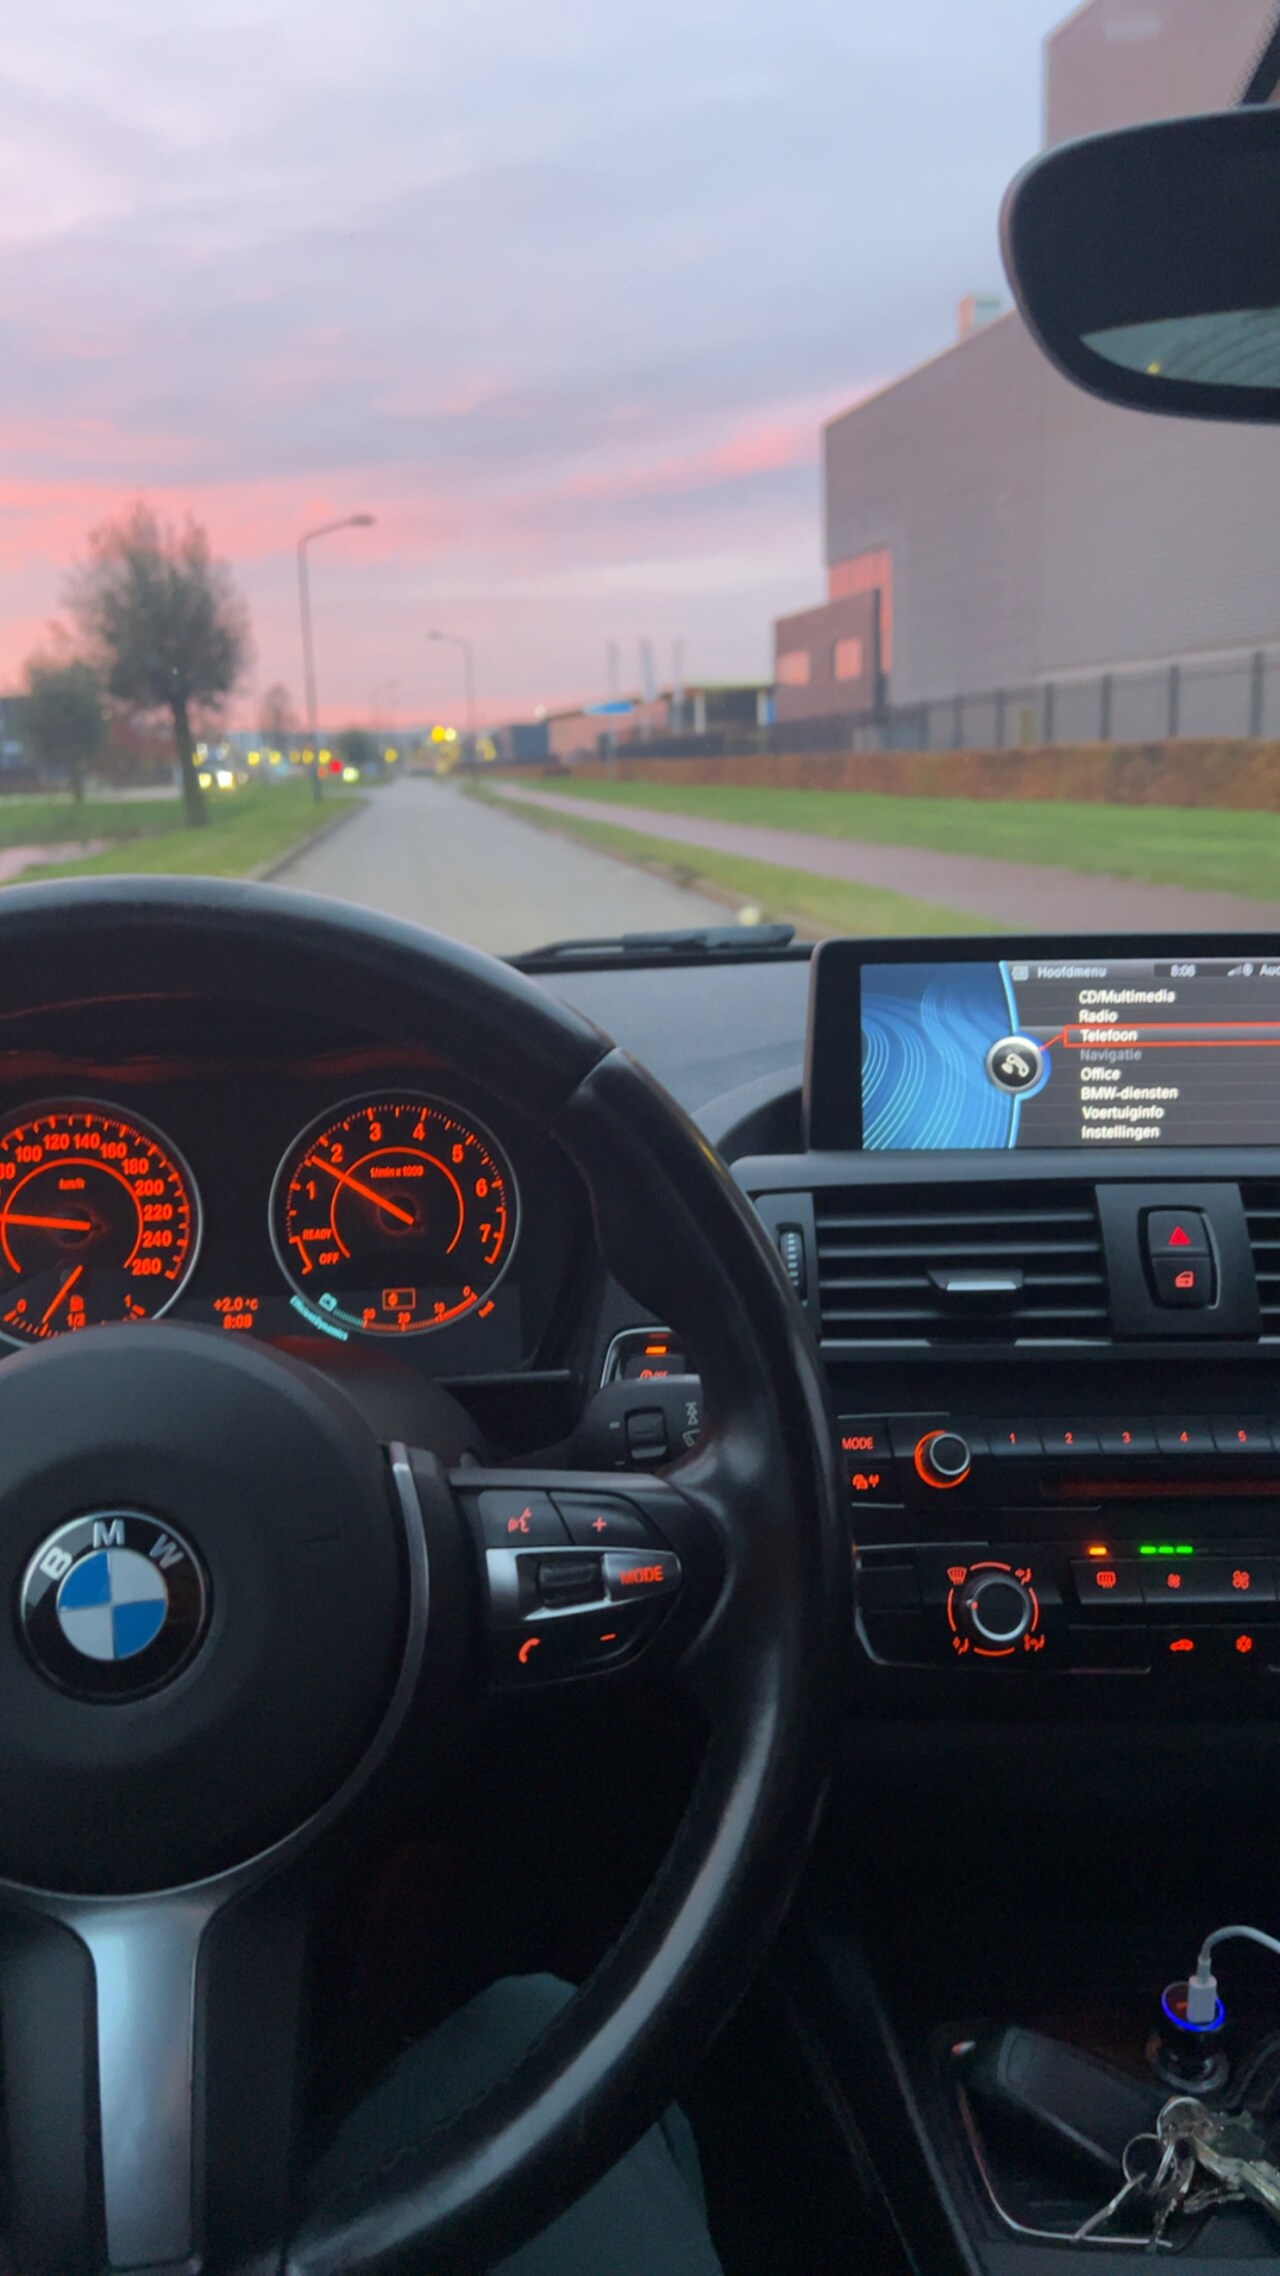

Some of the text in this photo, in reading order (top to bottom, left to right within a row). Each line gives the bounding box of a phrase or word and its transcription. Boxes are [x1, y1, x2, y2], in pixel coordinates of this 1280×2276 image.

[1037, 965, 1107, 979] Hoofdmenu
[1078, 989, 1175, 1005] CD/Multimedia
[1079, 1009, 1118, 1024] Radio
[1080, 1028, 1138, 1043] Telefoon
[1080, 1048, 1142, 1064] Navigatie
[1080, 1066, 1121, 1082] Office
[1081, 1085, 1178, 1101] BMW-diensten
[1082, 1105, 1165, 1121] Voertuiginfo
[369, 1122, 382, 1142] 3
[412, 1121, 426, 1141] 4
[1081, 1124, 1160, 1140] Instellingen
[43, 1133, 70, 1150] 120
[73, 1132, 100, 1149] 140
[15, 1145, 42, 1163] 100
[100, 1142, 127, 1159] 160
[331, 1143, 344, 1163] 2
[451, 1144, 464, 1163] 5
[122, 1158, 149, 1175] 180
[134, 1179, 164, 1197] 200
[305, 1180, 316, 1200] 1
[475, 1178, 488, 1198] 6
[143, 1204, 173, 1221] 220
[142, 1230, 172, 1247] 240
[302, 1228, 332, 1240] READY
[479, 1223, 491, 1244] 7
[319, 1252, 340, 1265] OFF
[16, 1299, 26, 1313] 0
[841, 1437, 874, 1450] MODE
[1009, 1433, 1016, 1444] 1
[1065, 1432, 1073, 1444] 2
[1122, 1431, 1131, 1444] 3
[1179, 1431, 1188, 1442] 4
[1238, 1430, 1247, 1442] 5
[40, 1518, 184, 1581] BMW
[619, 1565, 664, 1585] MODE
